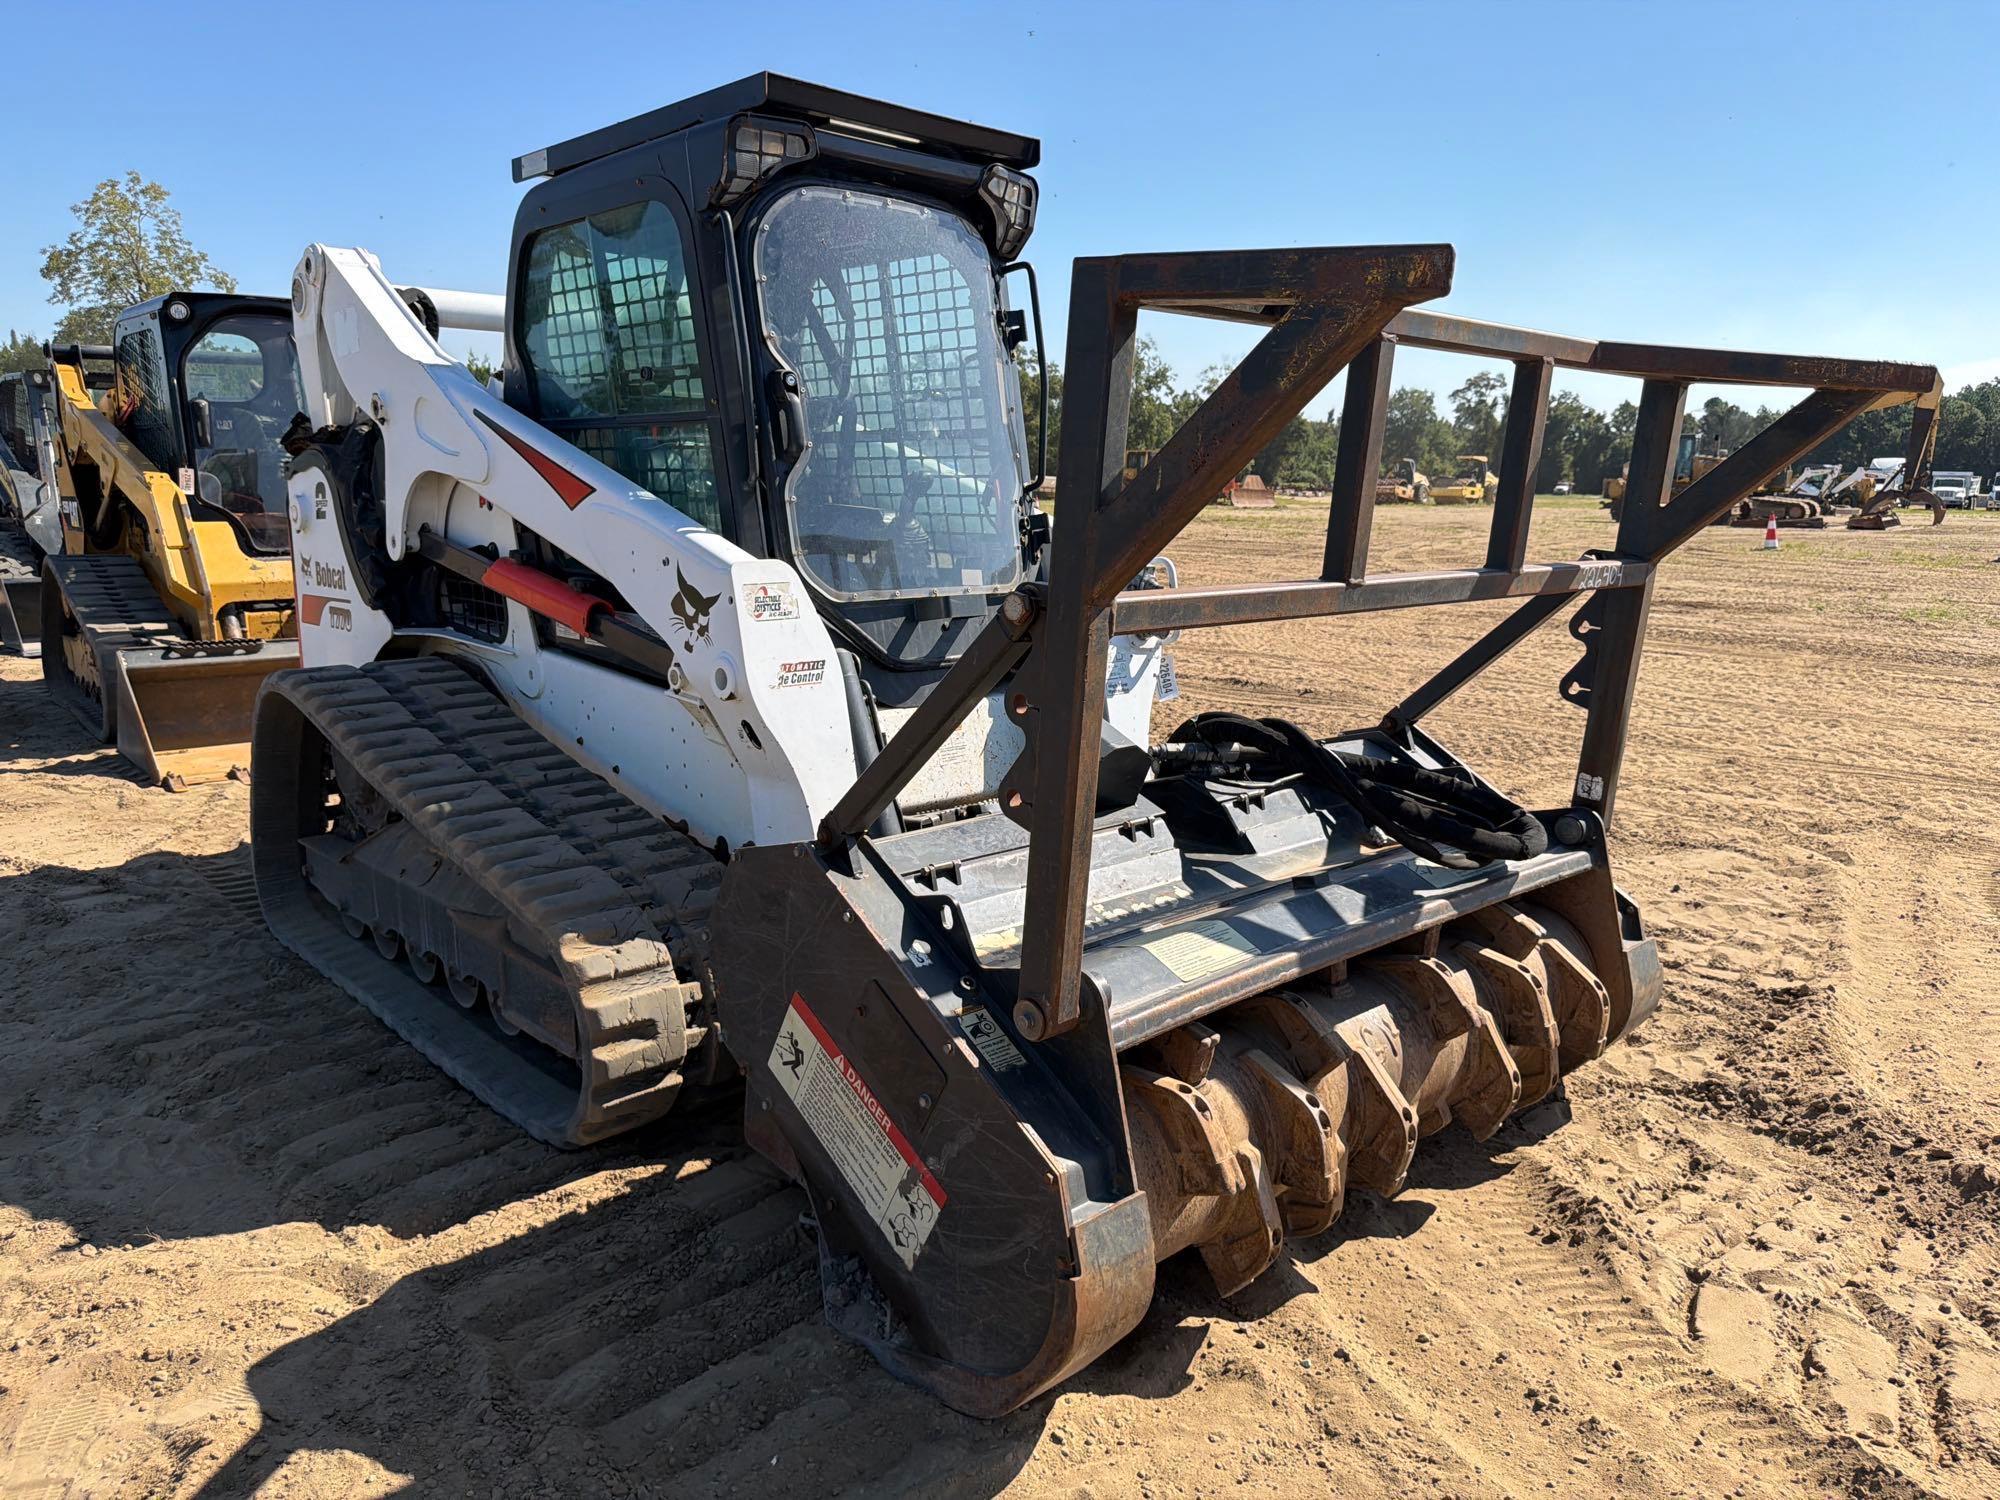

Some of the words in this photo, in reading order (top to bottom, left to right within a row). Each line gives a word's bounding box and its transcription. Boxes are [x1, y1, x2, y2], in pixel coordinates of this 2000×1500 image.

[315, 561, 346, 591] Bobcat
[753, 603, 781, 613] JOYSTICKS
[791, 671, 824, 684] Control
[846, 1067, 892, 1132] DANGER
